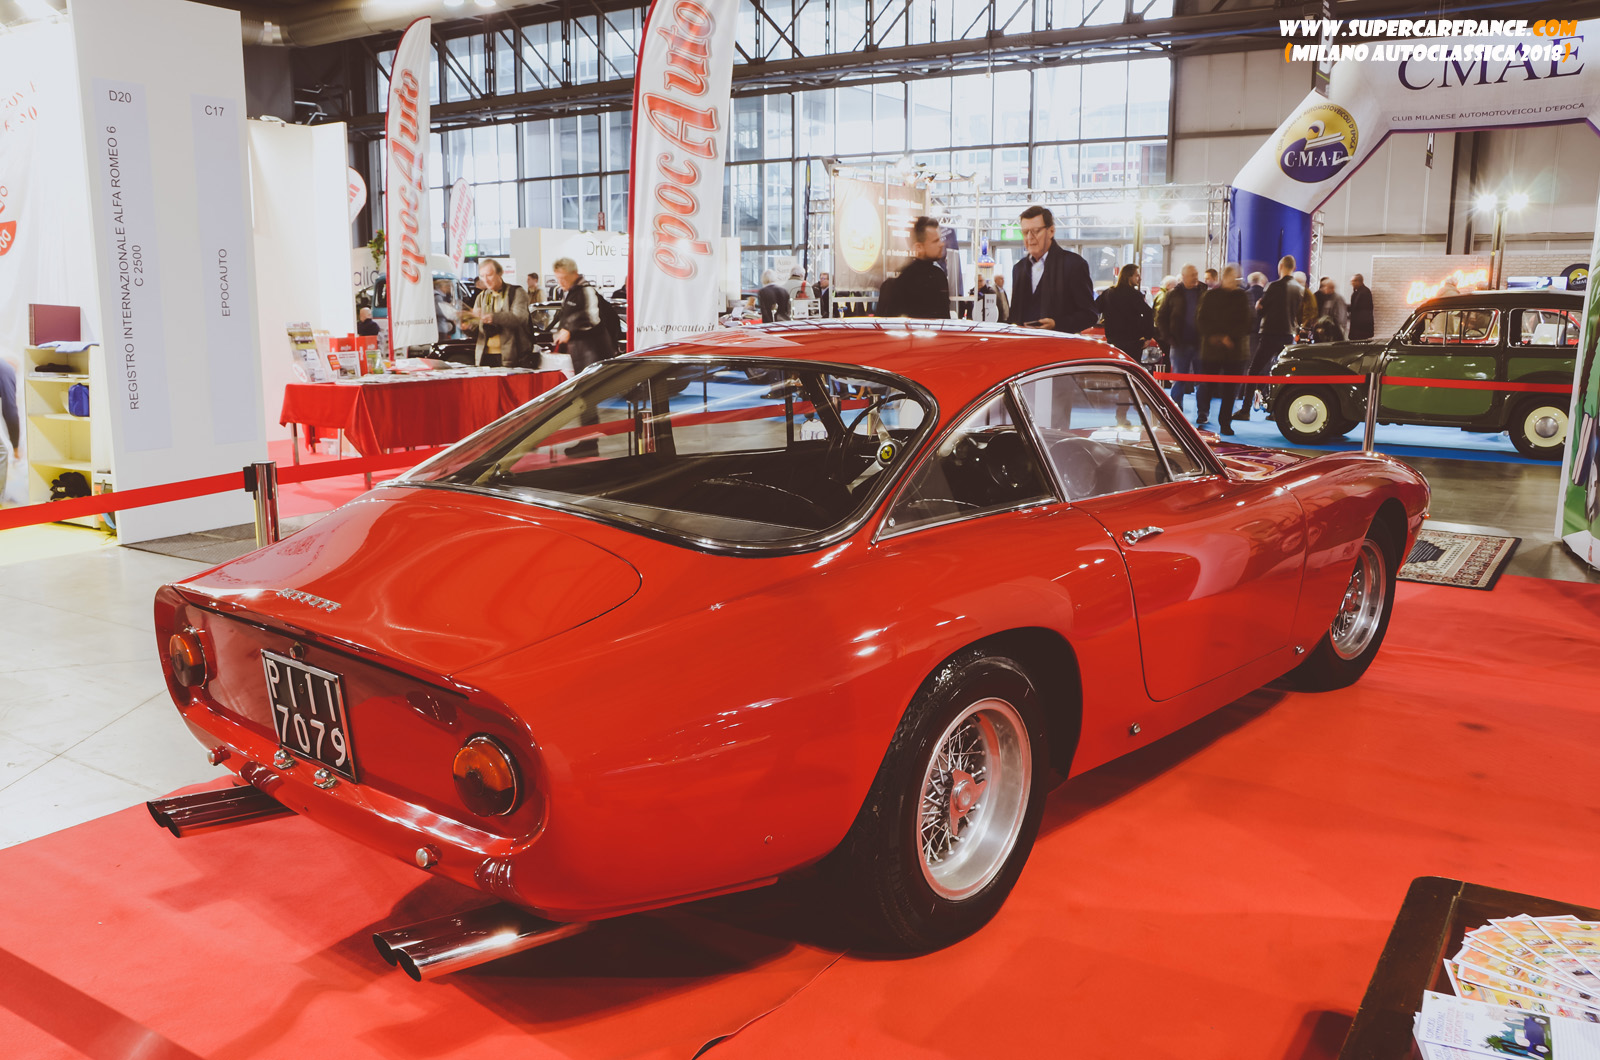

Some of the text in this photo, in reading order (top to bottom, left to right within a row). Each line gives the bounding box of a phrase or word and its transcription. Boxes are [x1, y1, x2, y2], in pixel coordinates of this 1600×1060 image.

[108, 89, 132, 103] D20
[204, 105, 225, 116] C17
[1415, 113, 1457, 121] MILANESE
[1458, 107, 1543, 119] AUTOMOTOVEICOLI
[1545, 102, 1585, 113] D'EPOCA
[586, 240, 617, 256] Drive
[106, 125, 139, 410] REGISTRO INTERNAZIONALE ALFA ROMEO 6
[131, 244, 144, 287] C 2500
[218, 248, 231, 317] EPOCAUTO
[276, 704, 347, 768] 7079
